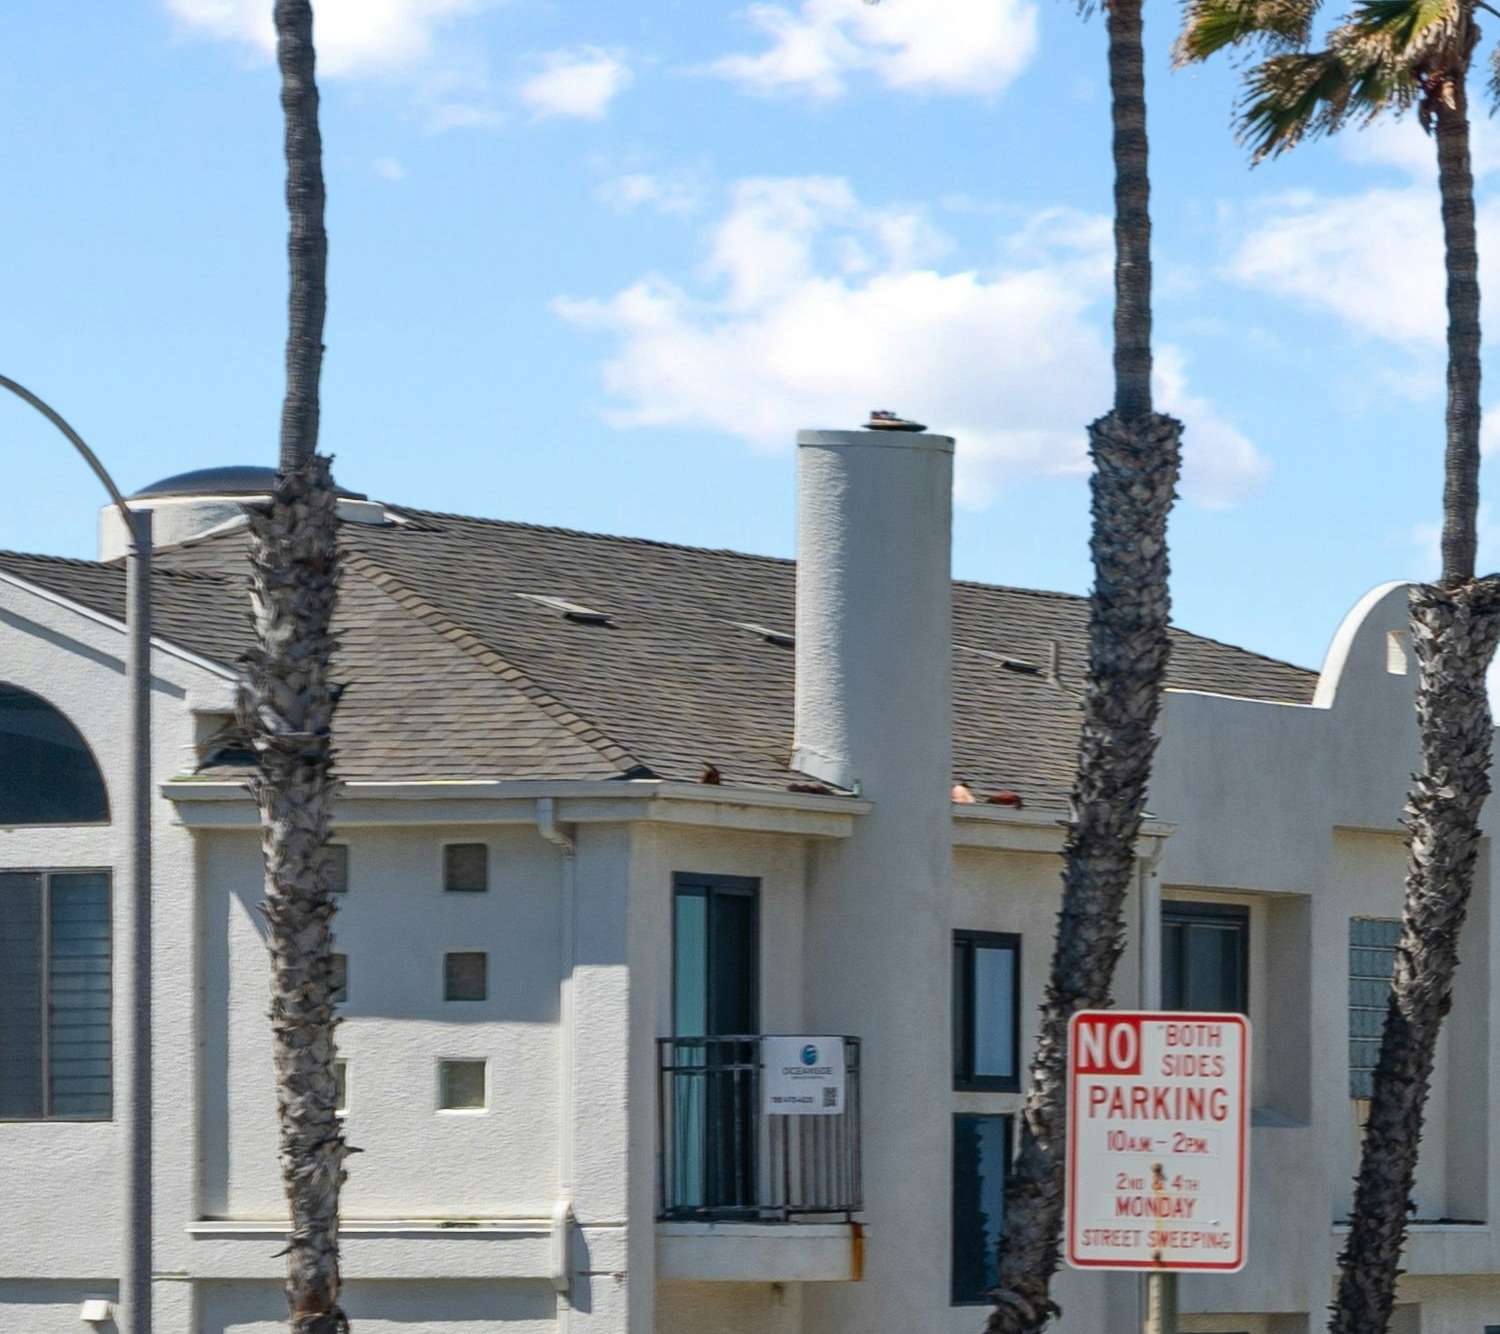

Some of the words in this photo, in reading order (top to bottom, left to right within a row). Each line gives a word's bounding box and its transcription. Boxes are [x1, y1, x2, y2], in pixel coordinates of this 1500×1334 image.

[1078, 1022, 1137, 1070] NO
[1165, 1024, 1223, 1048] BOTH
[1161, 1054, 1226, 1078] SIDES
[1088, 1085, 1230, 1122] PARKING
[1116, 1172, 1144, 1191] 2ND
[1171, 1173, 1200, 1191] 4TH
[1115, 1195, 1198, 1218] MONDAY
[1081, 1229, 1142, 1248] STREET
[1147, 1230, 1232, 1250] SWEEPING
